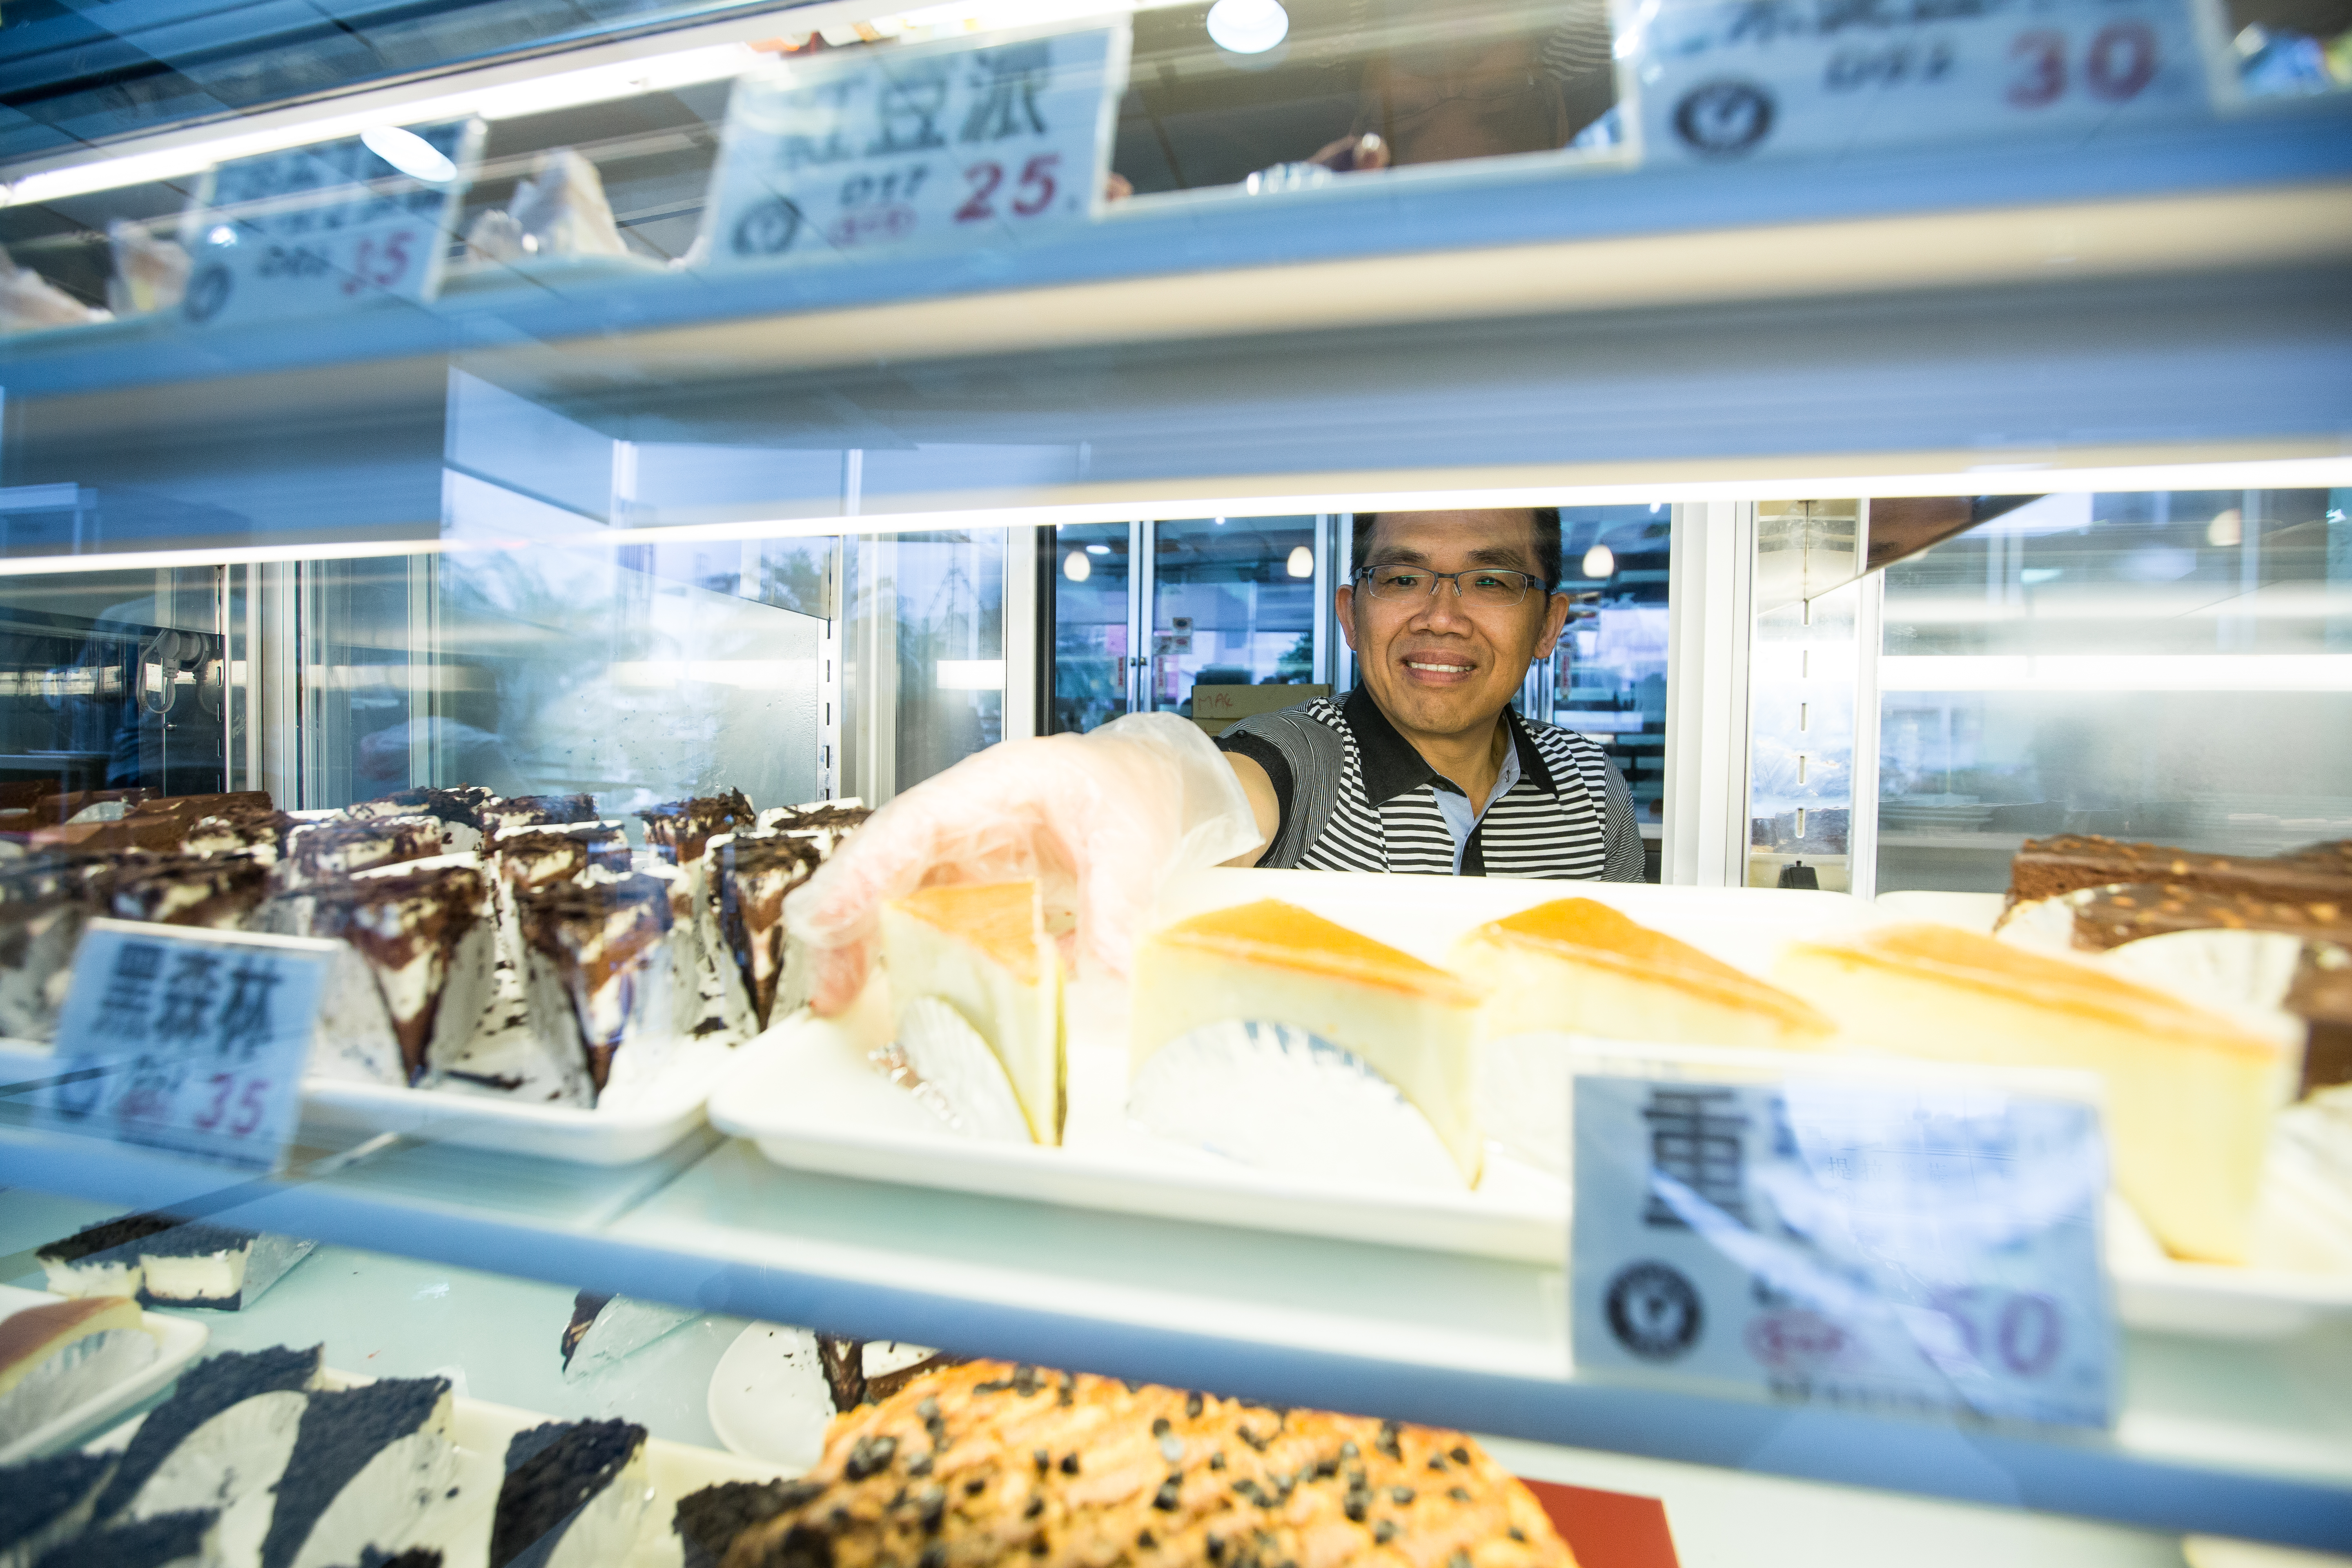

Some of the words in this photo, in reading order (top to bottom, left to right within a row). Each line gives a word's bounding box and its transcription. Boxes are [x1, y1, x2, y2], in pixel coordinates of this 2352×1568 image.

[2004, 17, 2163, 110] 30
[950, 150, 1063, 225] 25
[87, 941, 283, 1062] 黑森林
[193, 1071, 274, 1140] 35
